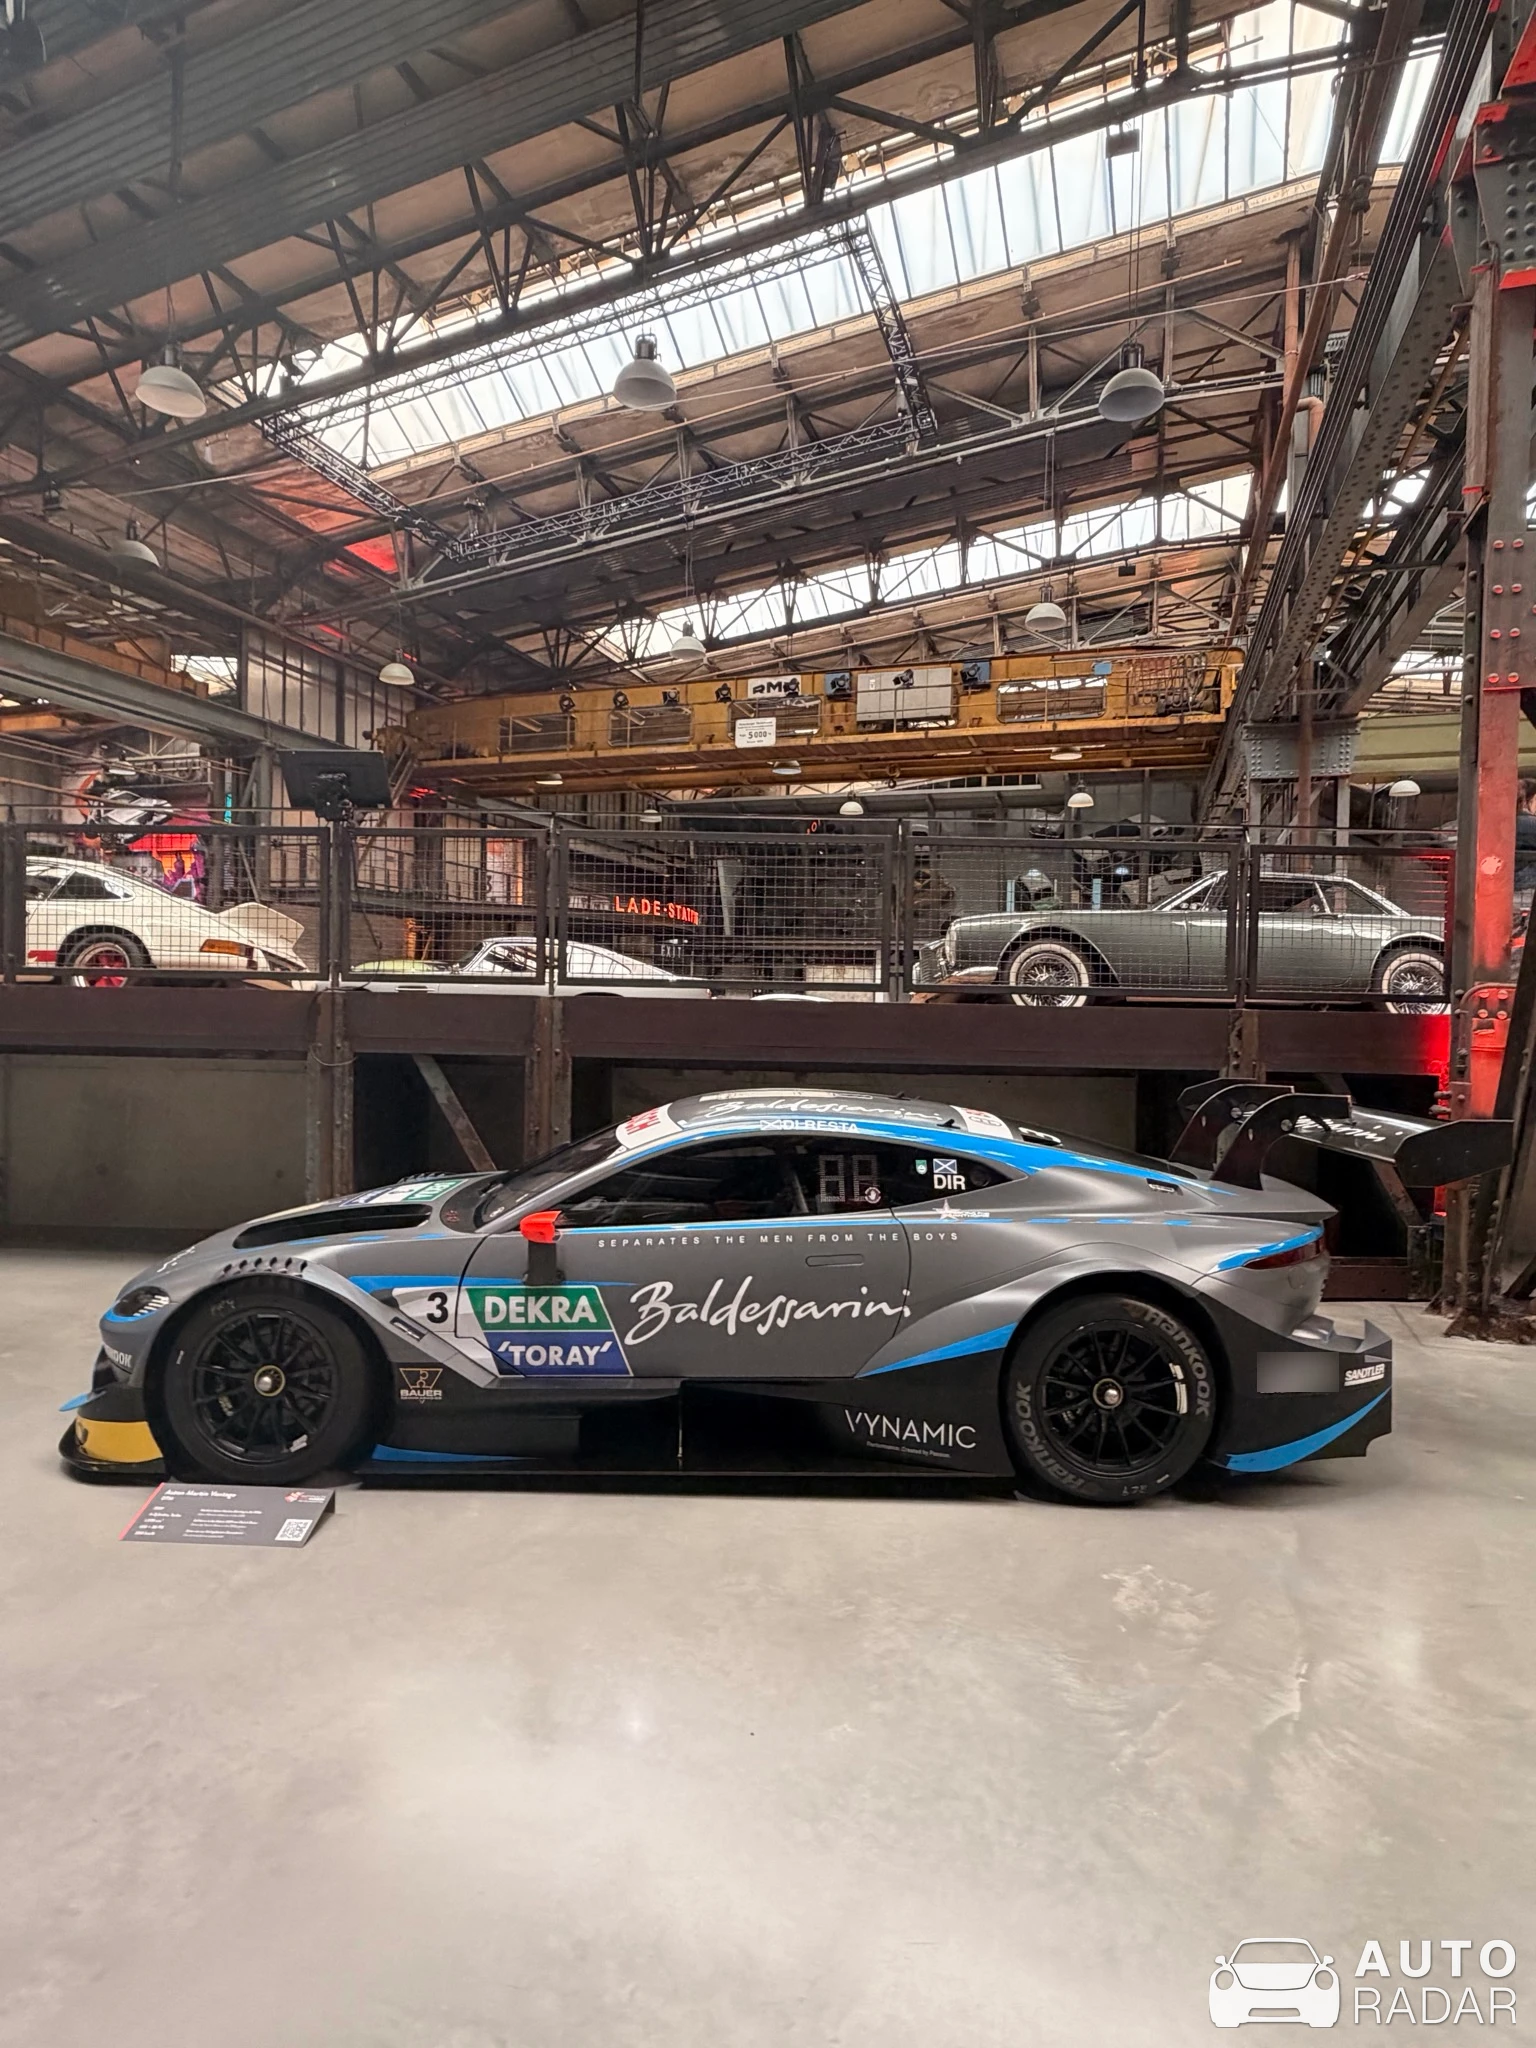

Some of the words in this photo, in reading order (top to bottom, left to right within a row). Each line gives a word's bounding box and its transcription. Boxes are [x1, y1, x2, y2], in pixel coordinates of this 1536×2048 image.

[753, 680, 796, 695] RM
[748, 731, 767, 739] 5000
[705, 1099, 942, 1120] Baldessarini
[804, 1120, 859, 1132] RESTA
[933, 1175, 966, 1190] DIR
[598, 1236, 700, 1247] SEPARATES
[714, 1235, 745, 1244] THE
[760, 1234, 793, 1243] MEN
[808, 1234, 853, 1242] FROM
[867, 1233, 899, 1241] THE
[913, 1232, 958, 1241] BOYS
[427, 1291, 449, 1324] 3
[484, 1295, 598, 1324] DEKRA
[624, 1276, 911, 1345] Baldessarini
[1344, 1363, 1385, 1381] SANDTLER
[400, 1389, 442, 1397] BAUER
[844, 1409, 977, 1449] VYNAMIC
